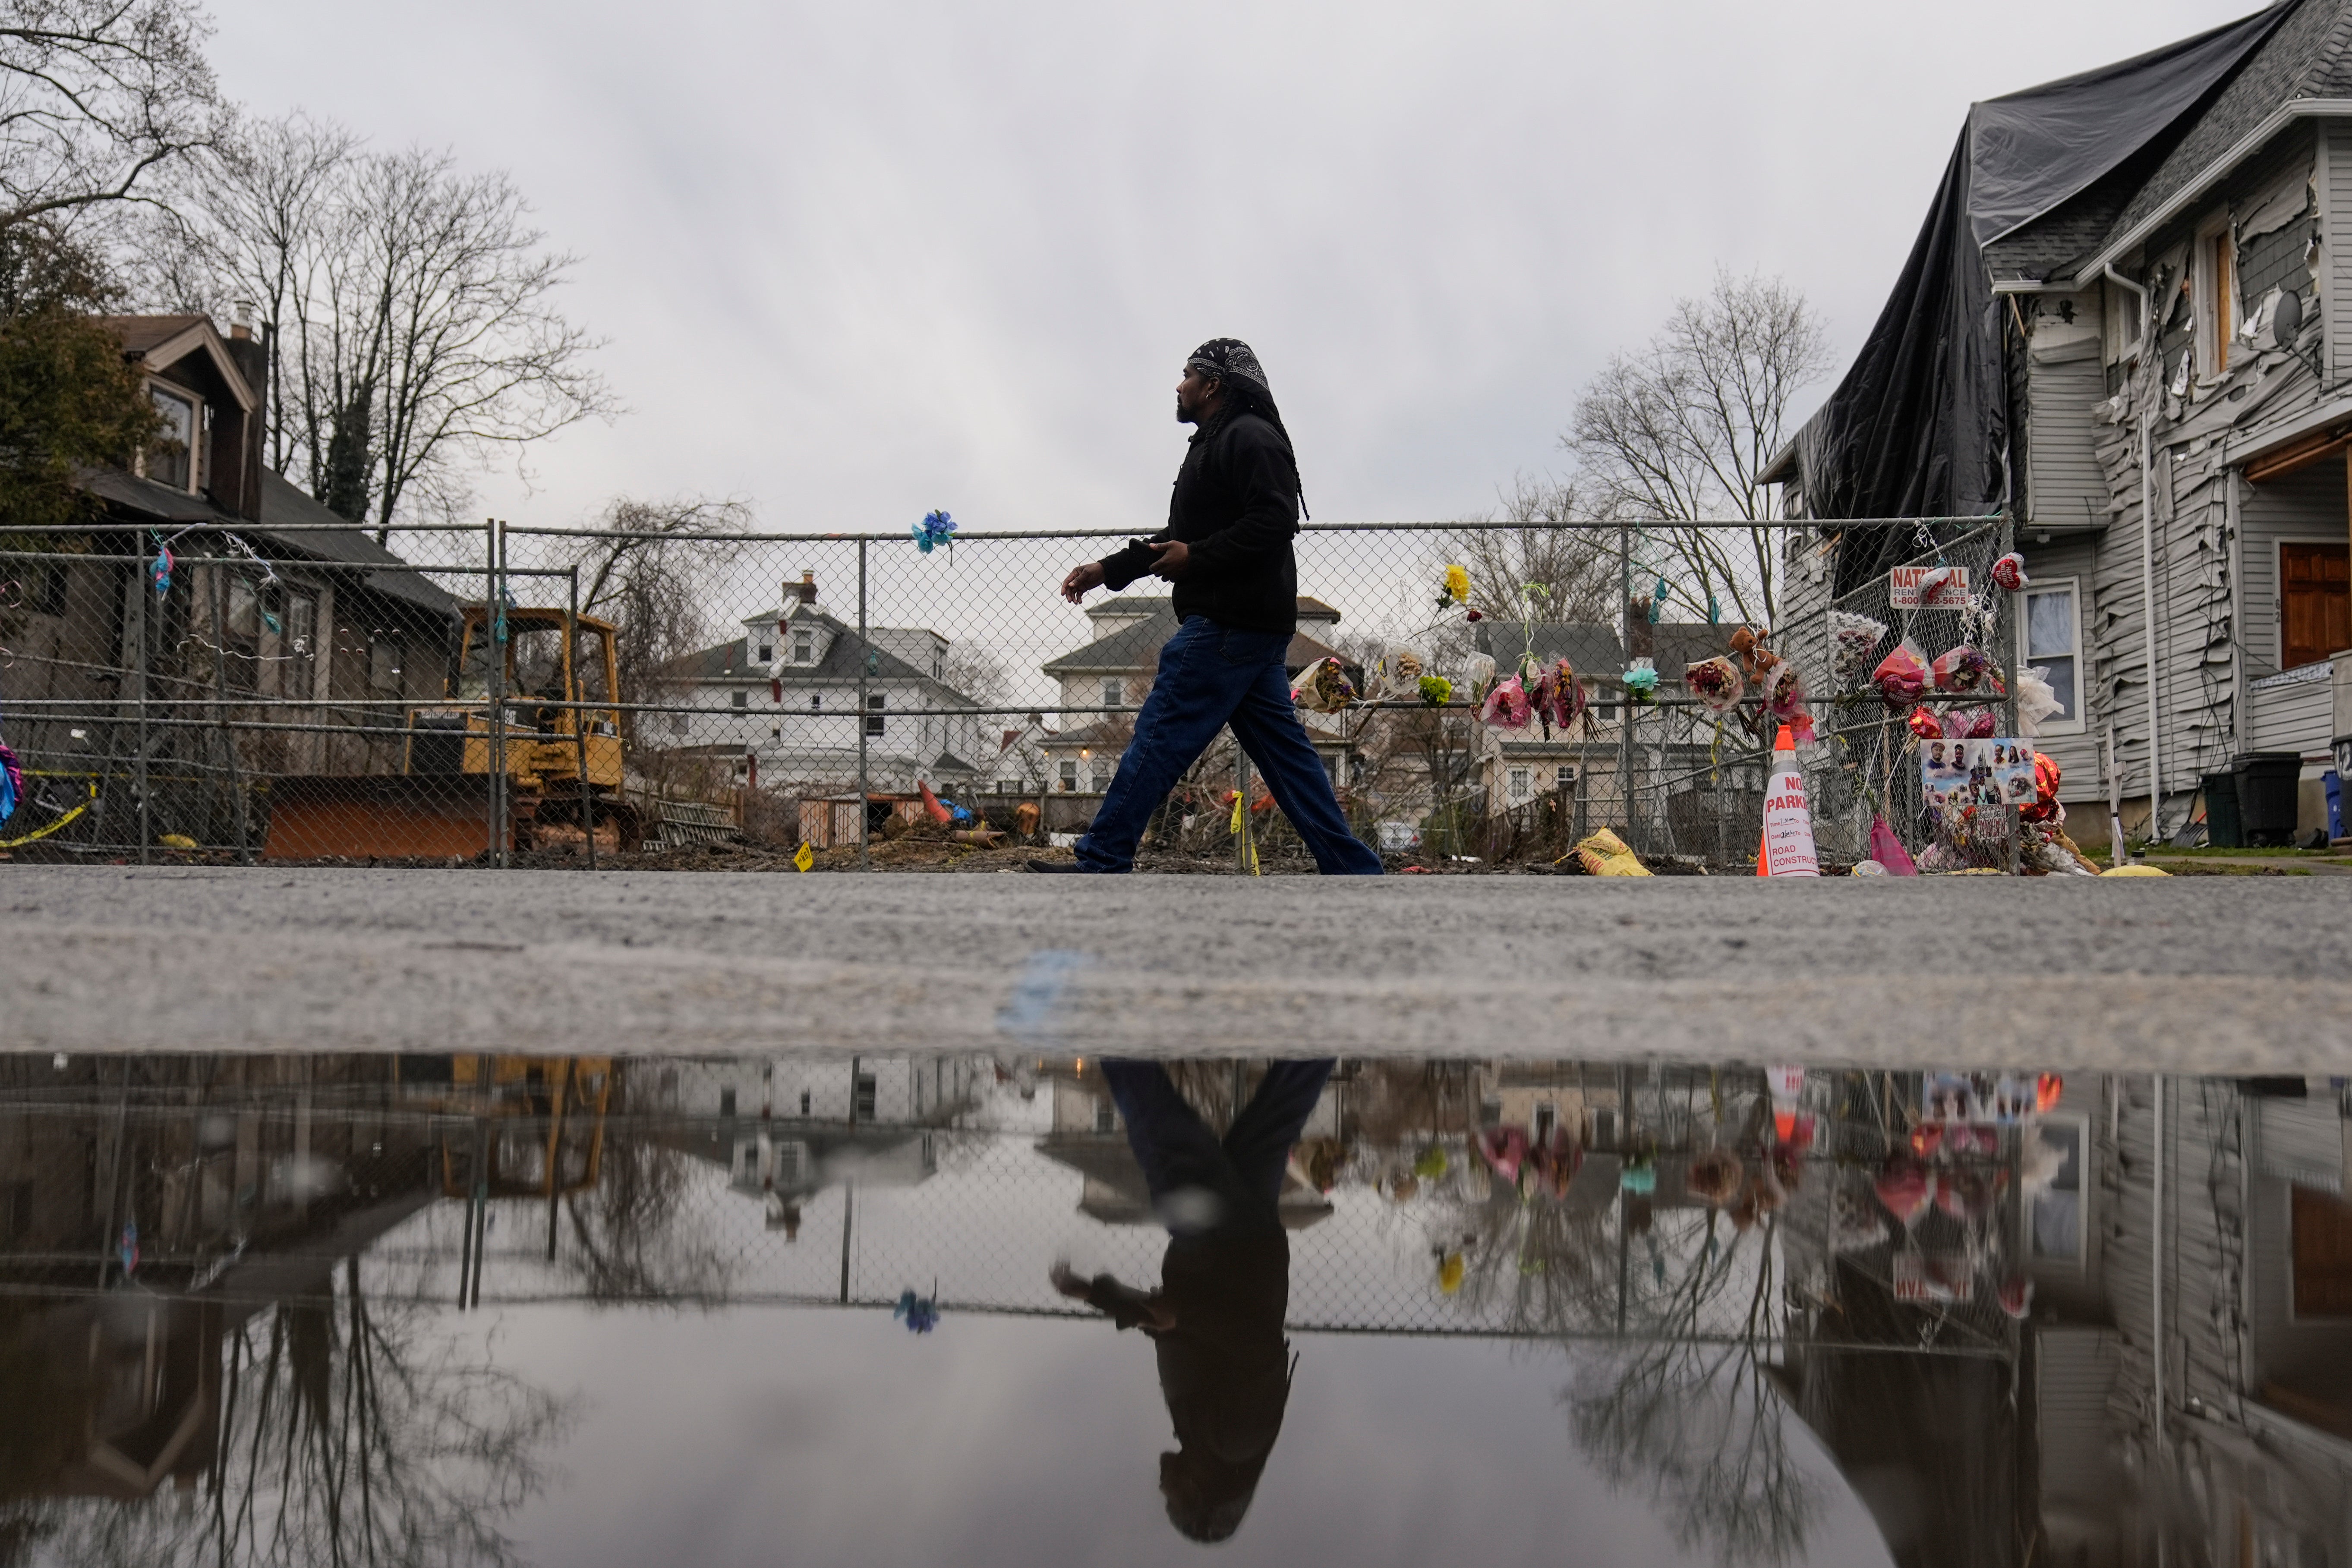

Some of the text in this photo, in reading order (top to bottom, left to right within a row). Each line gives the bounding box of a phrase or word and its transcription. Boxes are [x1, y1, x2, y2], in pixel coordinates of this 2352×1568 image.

[1894, 569, 1966, 588] NATAL
[2006, 566, 2014, 582] HAPPY
[1785, 777, 1802, 790] NO
[1772, 845, 1795, 856] ROAD
